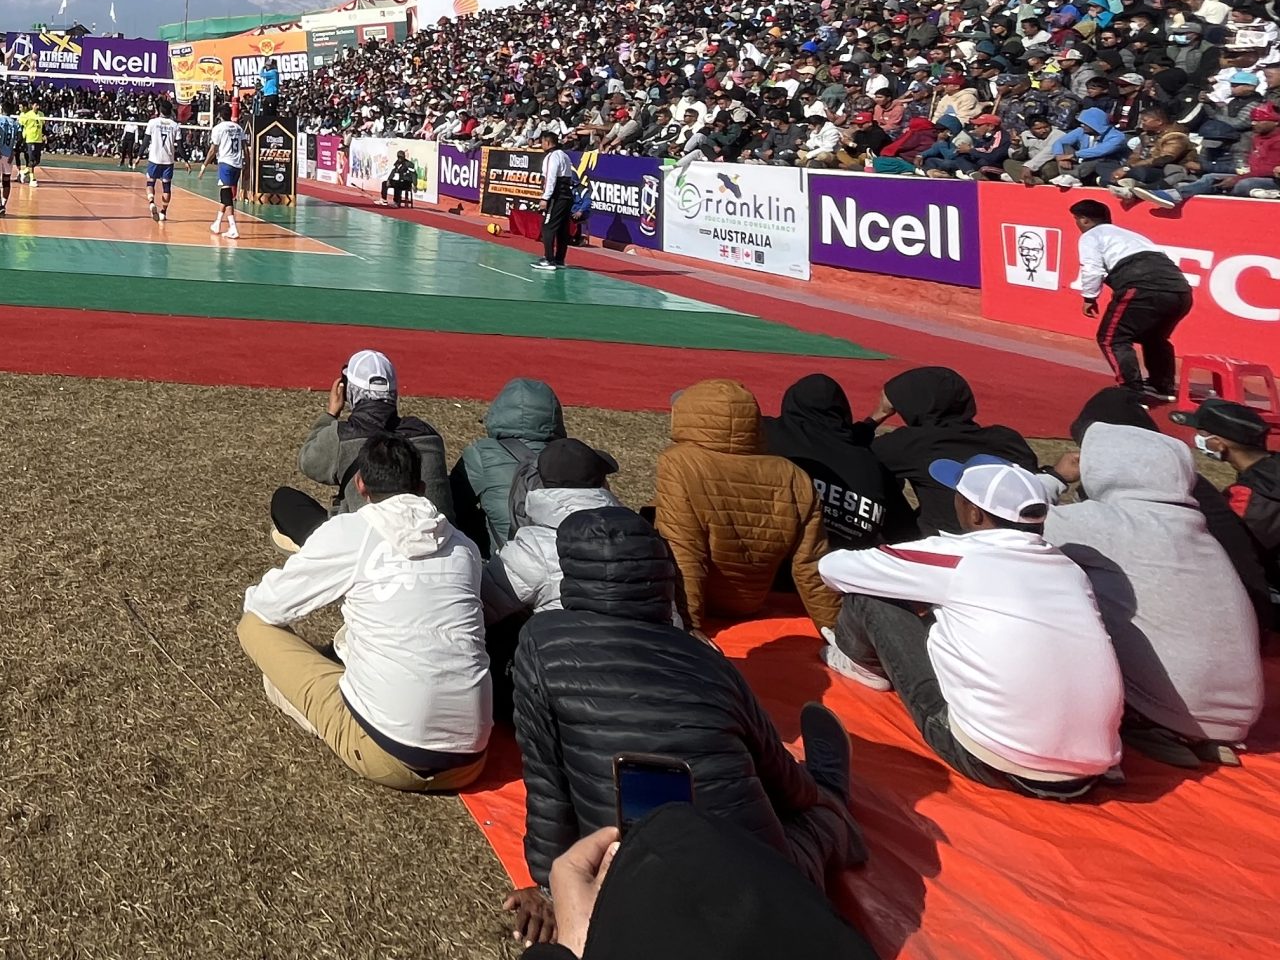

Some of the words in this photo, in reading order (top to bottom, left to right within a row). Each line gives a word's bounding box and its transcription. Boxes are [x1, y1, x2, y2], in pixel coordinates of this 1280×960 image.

[39, 50, 80, 64] XTREME
[93, 49, 157, 74] Ncell
[271, 52, 309, 73] IGER
[161, 132, 168, 147] 7
[260, 147, 292, 158] TIGER
[509, 153, 529, 169] Ncell
[441, 155, 479, 189] Ncell
[502, 169, 529, 183] TIGER
[529, 171, 542, 184] CU
[590, 180, 639, 207] XTREME
[616, 205, 641, 217] DRINK
[705, 190, 796, 224] Franklin
[704, 215, 742, 226] EDUCATION
[744, 220, 796, 233] CONSULTANCY
[821, 194, 961, 261] Ncell
[712, 228, 772, 249] AUSTRALIA
